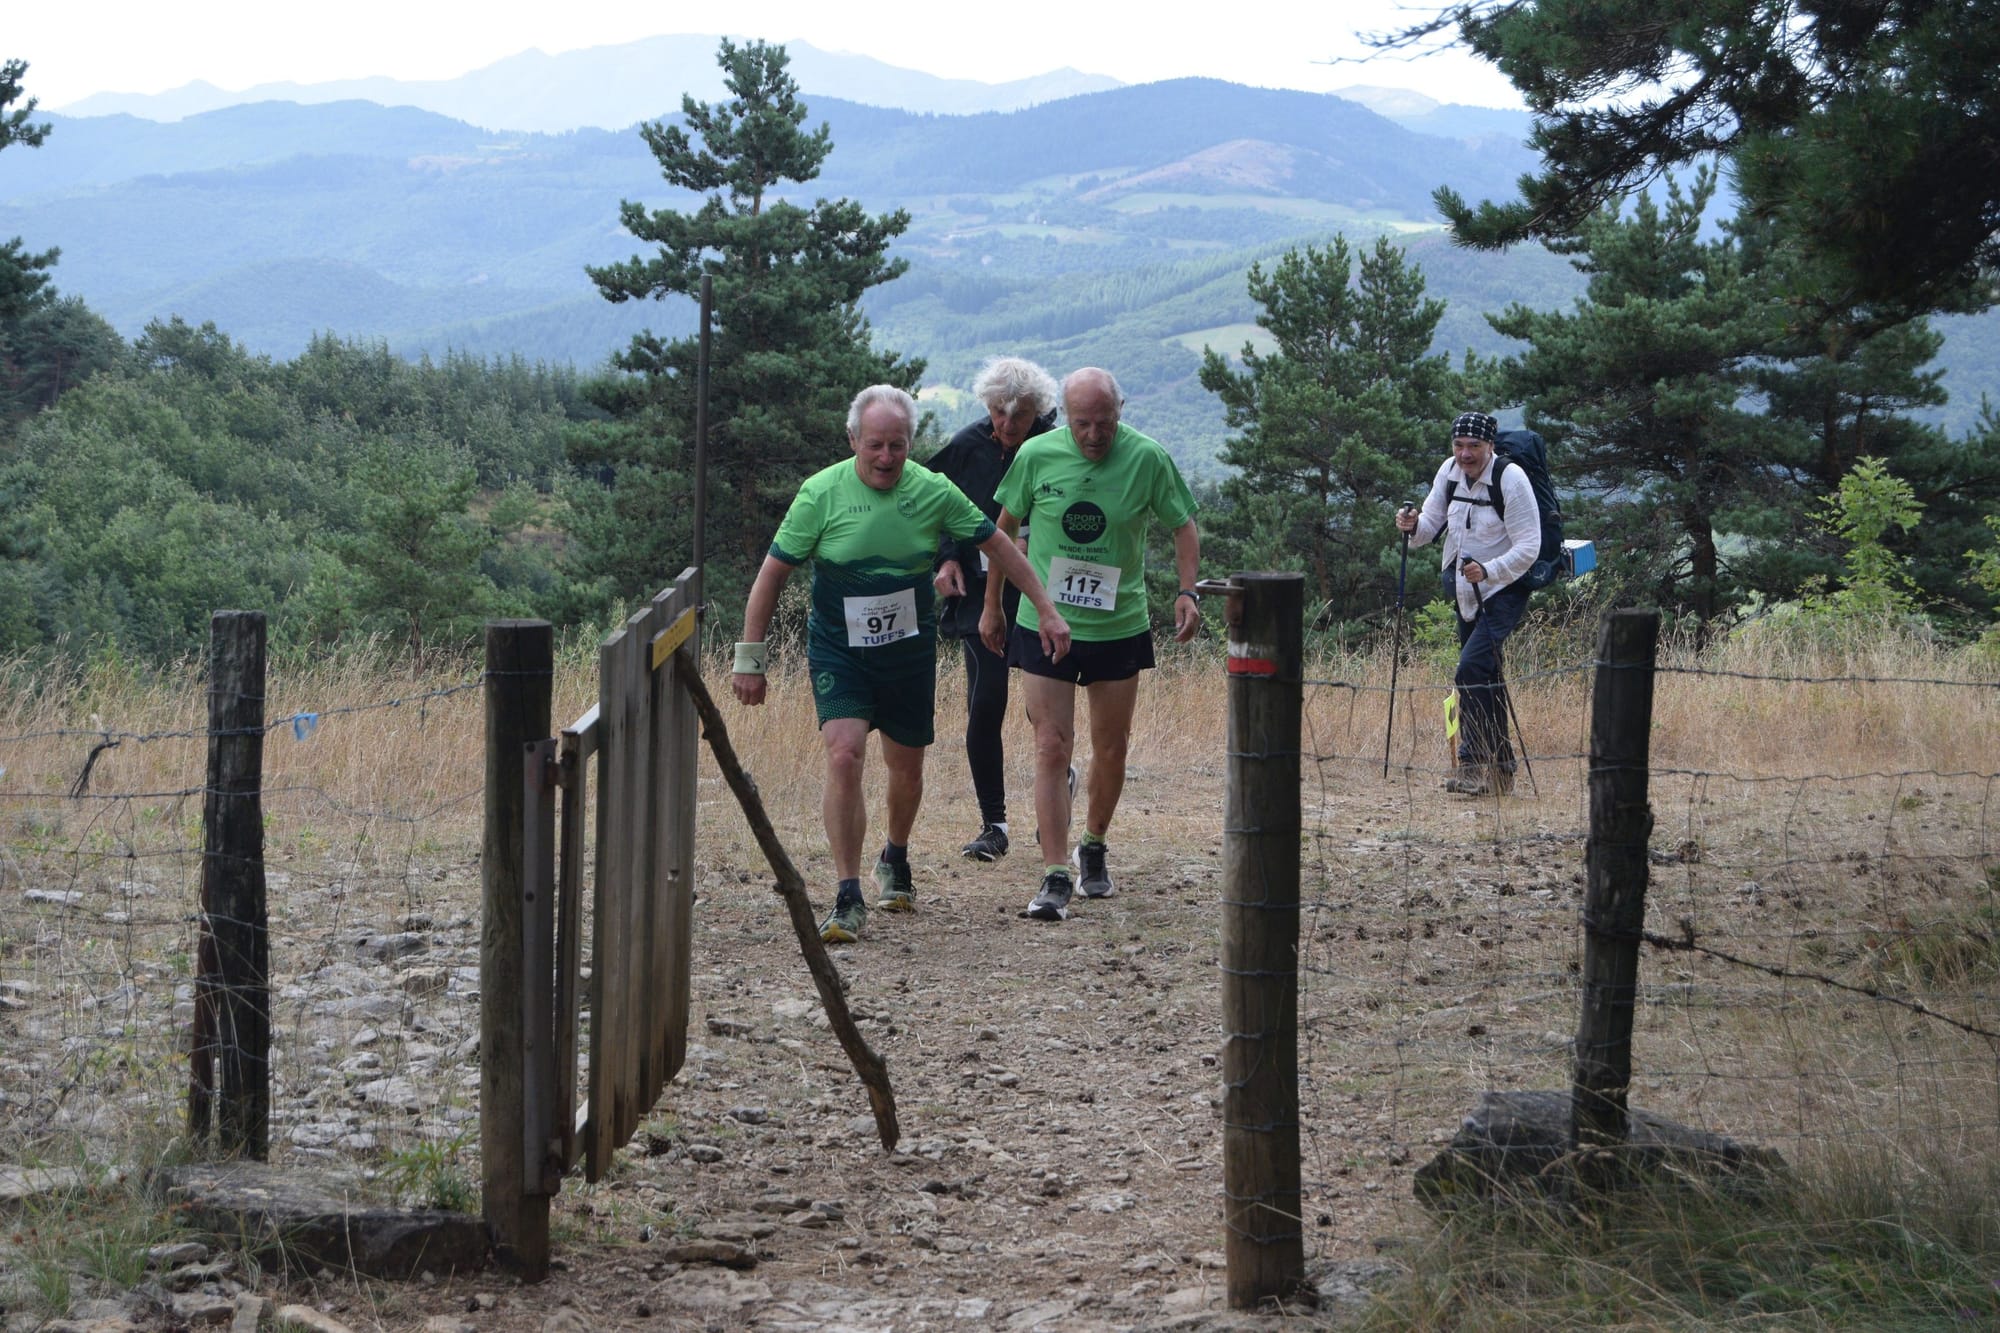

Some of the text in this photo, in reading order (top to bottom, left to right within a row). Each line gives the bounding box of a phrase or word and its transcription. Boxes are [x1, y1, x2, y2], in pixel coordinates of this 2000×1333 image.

[1066, 514, 1103, 522] SPORT
[1069, 522, 1099, 531] 2000
[1065, 575, 1101, 594] 117
[1059, 592, 1102, 606] TUFF'S
[867, 613, 897, 634] 97
[862, 628, 905, 645] TUFF'S
